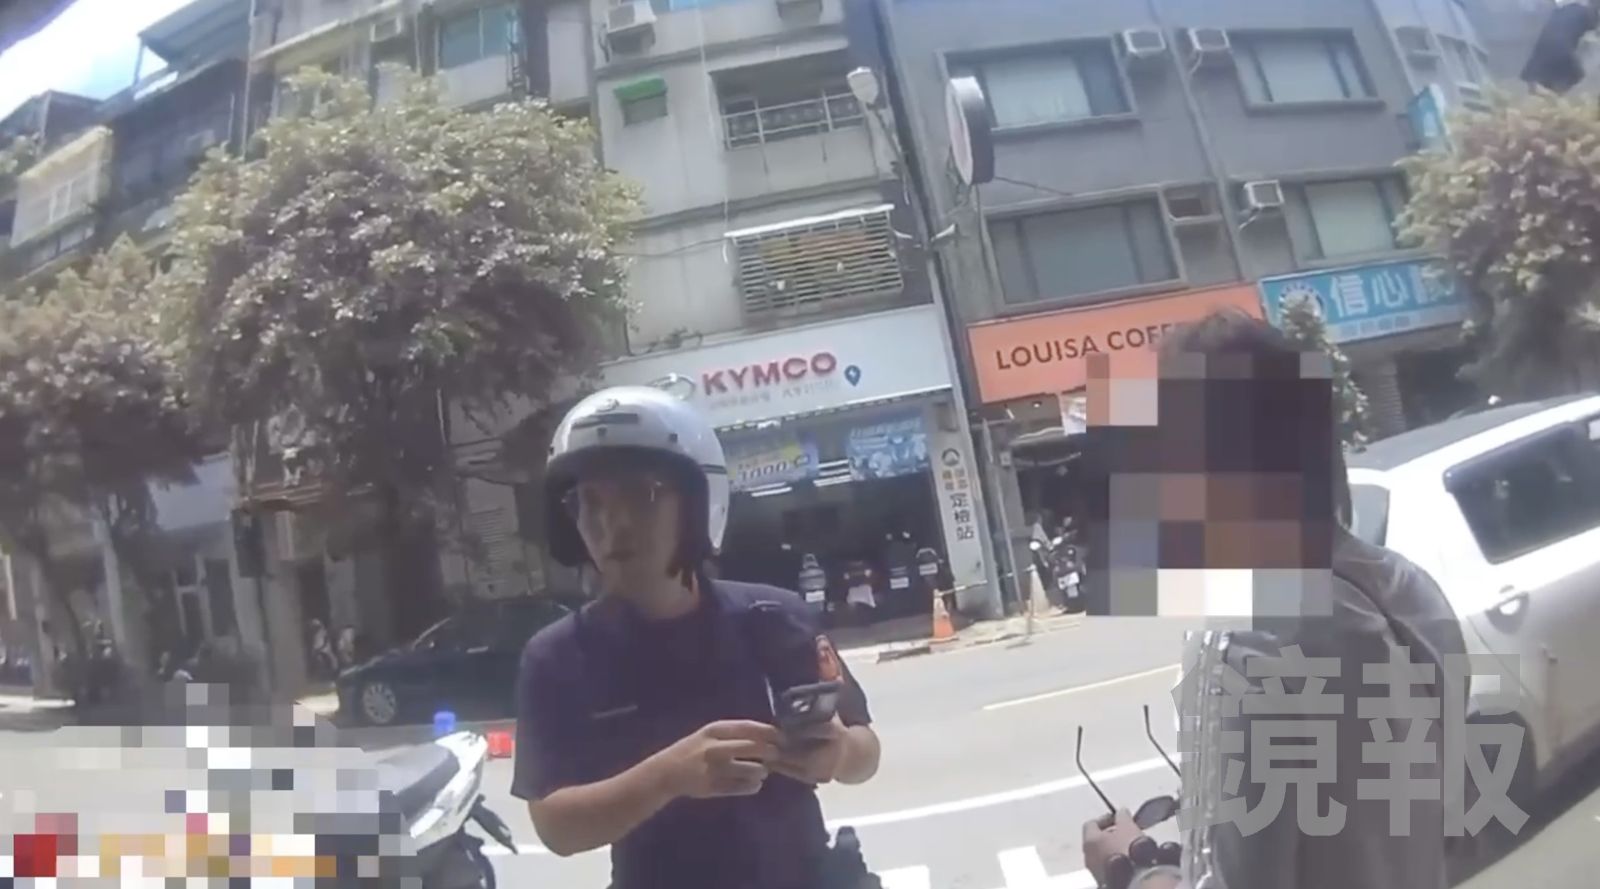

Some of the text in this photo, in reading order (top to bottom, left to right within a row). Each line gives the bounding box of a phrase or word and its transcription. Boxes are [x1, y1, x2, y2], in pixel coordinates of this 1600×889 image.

[996, 322, 1174, 371] LOUISA COFF
[702, 351, 837, 396] KYMCO
